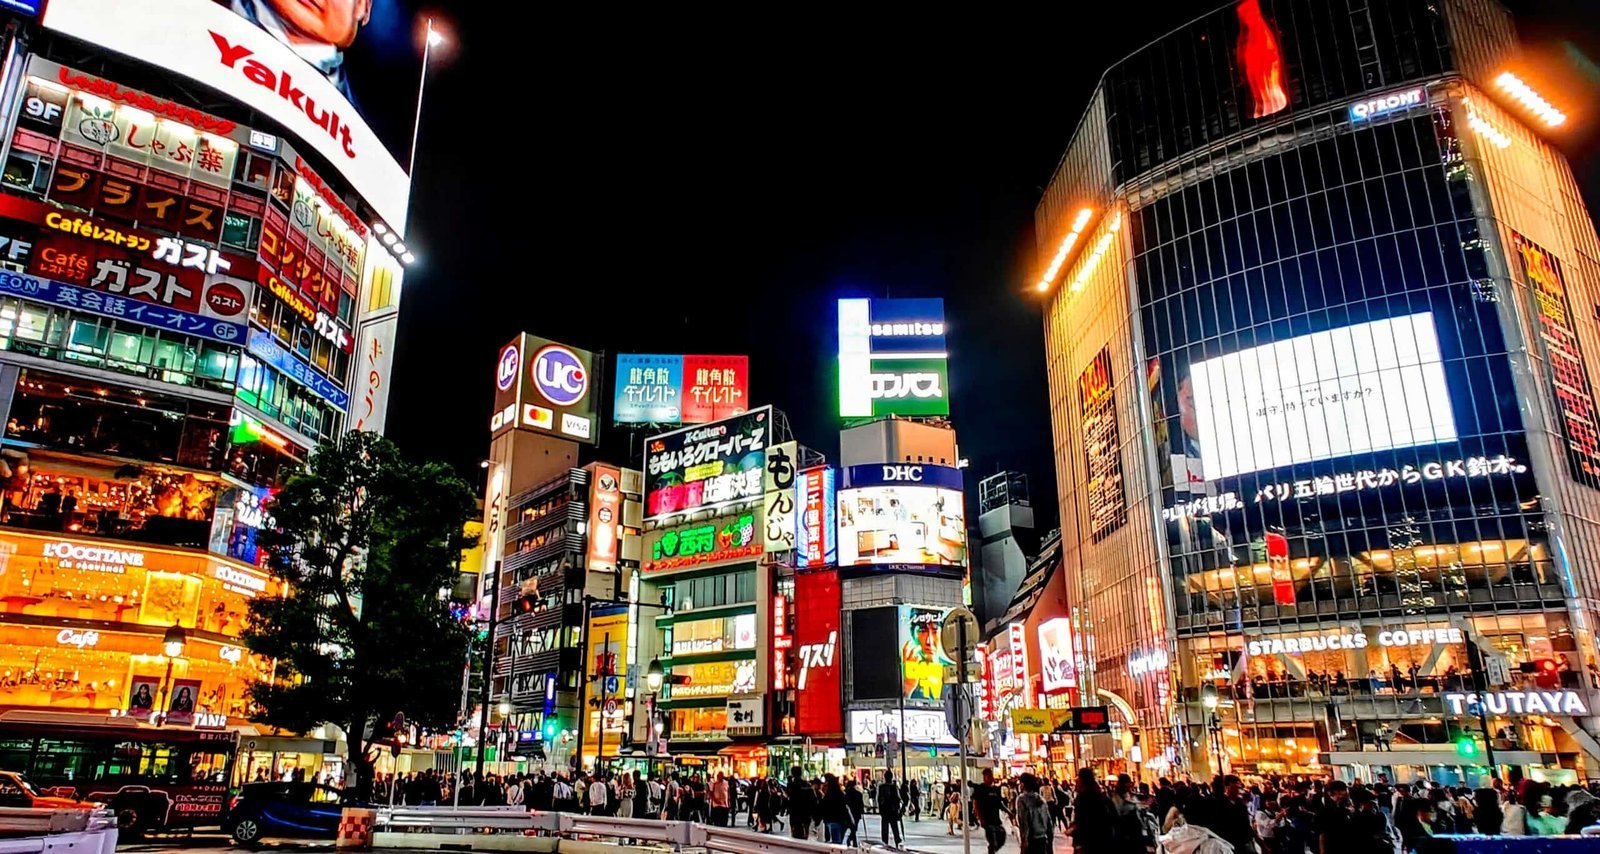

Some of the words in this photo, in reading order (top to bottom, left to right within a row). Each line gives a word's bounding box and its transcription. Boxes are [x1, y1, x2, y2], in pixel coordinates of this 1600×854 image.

[26, 97, 62, 119] 9F
[207, 29, 356, 158] Yakult
[127, 123, 224, 172] しゃぶ葉
[57, 168, 215, 231] プライス
[42, 247, 88, 270] Café
[153, 236, 231, 275] ガスト
[262, 227, 335, 302] コンタクト
[40, 263, 86, 280] レストラン
[91, 259, 192, 304] ガスト
[57, 286, 206, 331] 英会話イーオン
[216, 324, 235, 339] 6F
[211, 294, 241, 309] ガスト
[314, 311, 349, 349] ガスト
[630, 367, 669, 385] 龍角散
[696, 368, 736, 386] 龍角散
[565, 419, 588, 432] VISA
[882, 466, 923, 482] DHC
[767, 447, 795, 547] もんじゃ
[43, 542, 145, 567] L'OCCITANE
[56, 628, 99, 648] Café
[1249, 632, 1368, 657] STARBUCKS
[1378, 627, 1463, 647] COFFEE
[797, 631, 838, 691] クスリ
